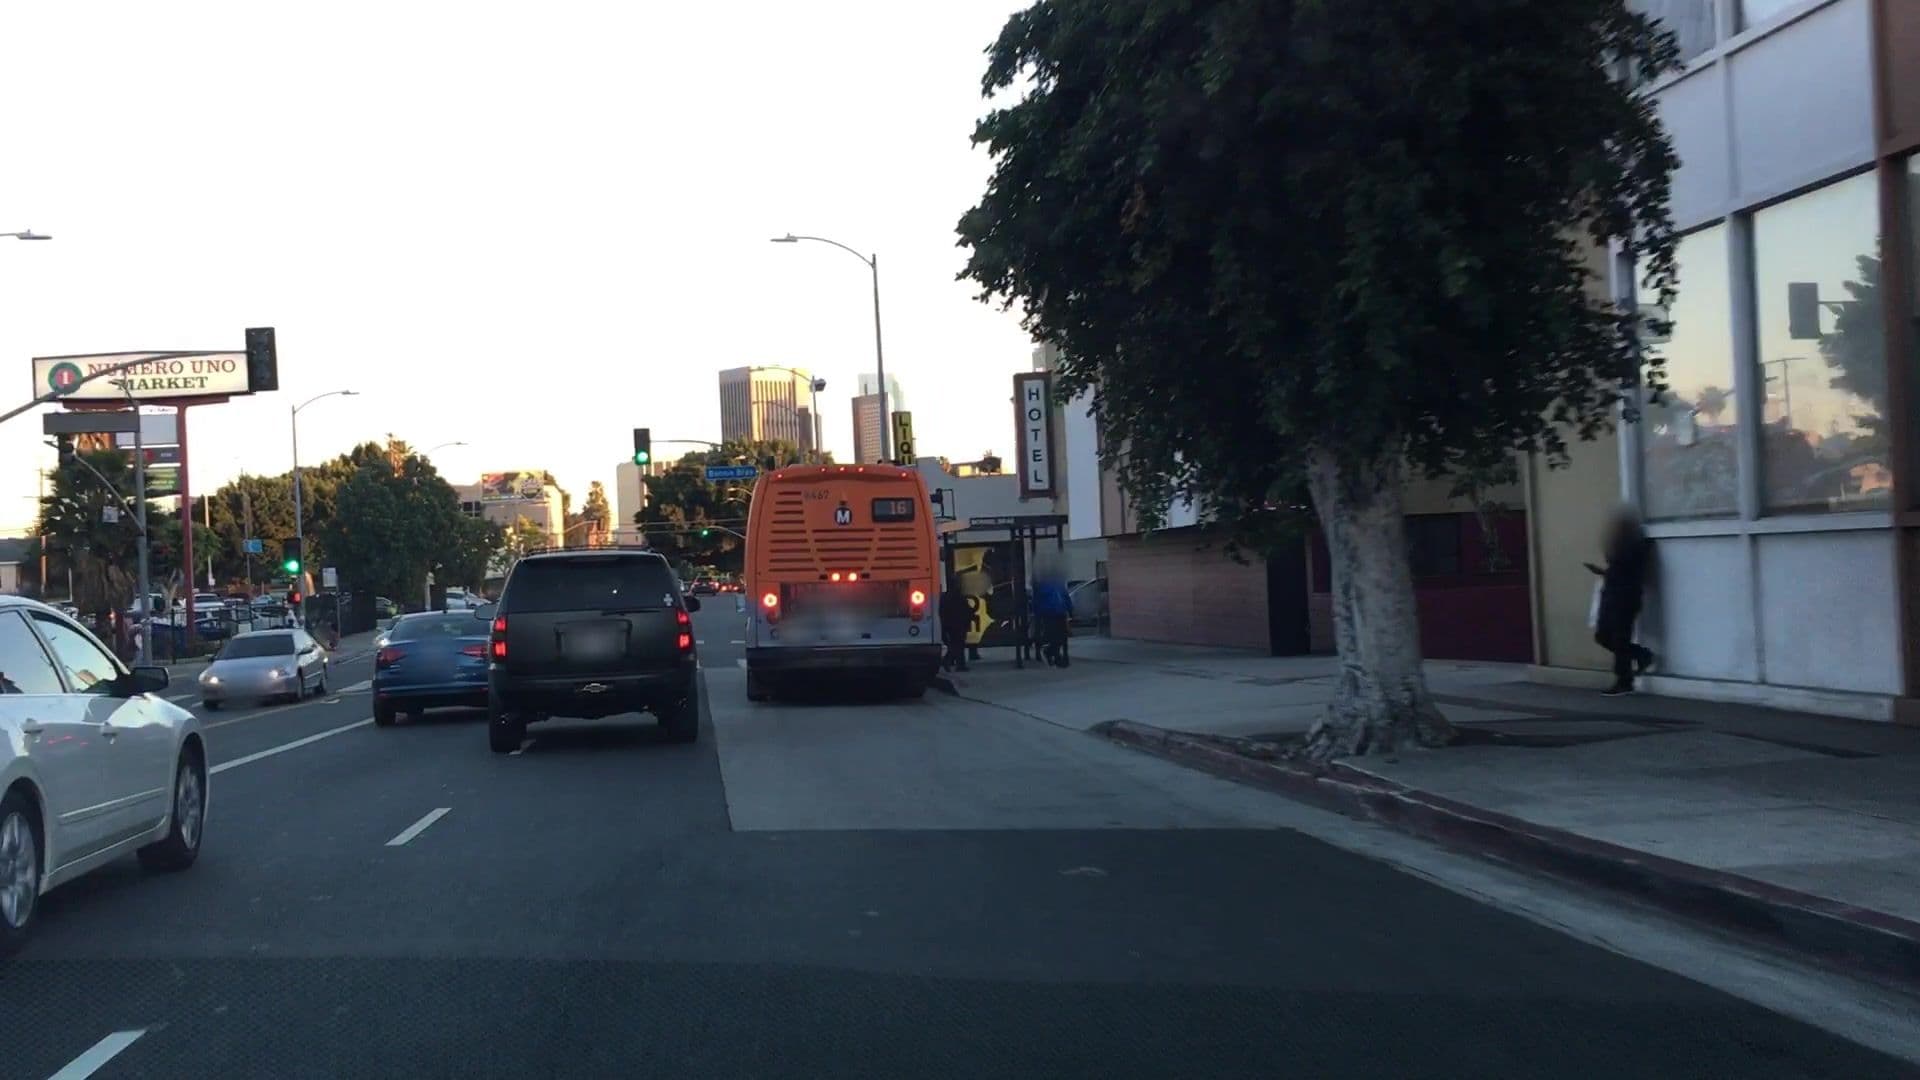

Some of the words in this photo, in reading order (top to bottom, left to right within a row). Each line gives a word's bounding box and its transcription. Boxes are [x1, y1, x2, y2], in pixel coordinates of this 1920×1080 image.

[191, 359, 236, 375] UNO
[117, 376, 209, 390] MARKET
[1027, 387, 1043, 483] HOTEL
[890, 501, 906, 515] 16
[837, 513, 850, 524] M
